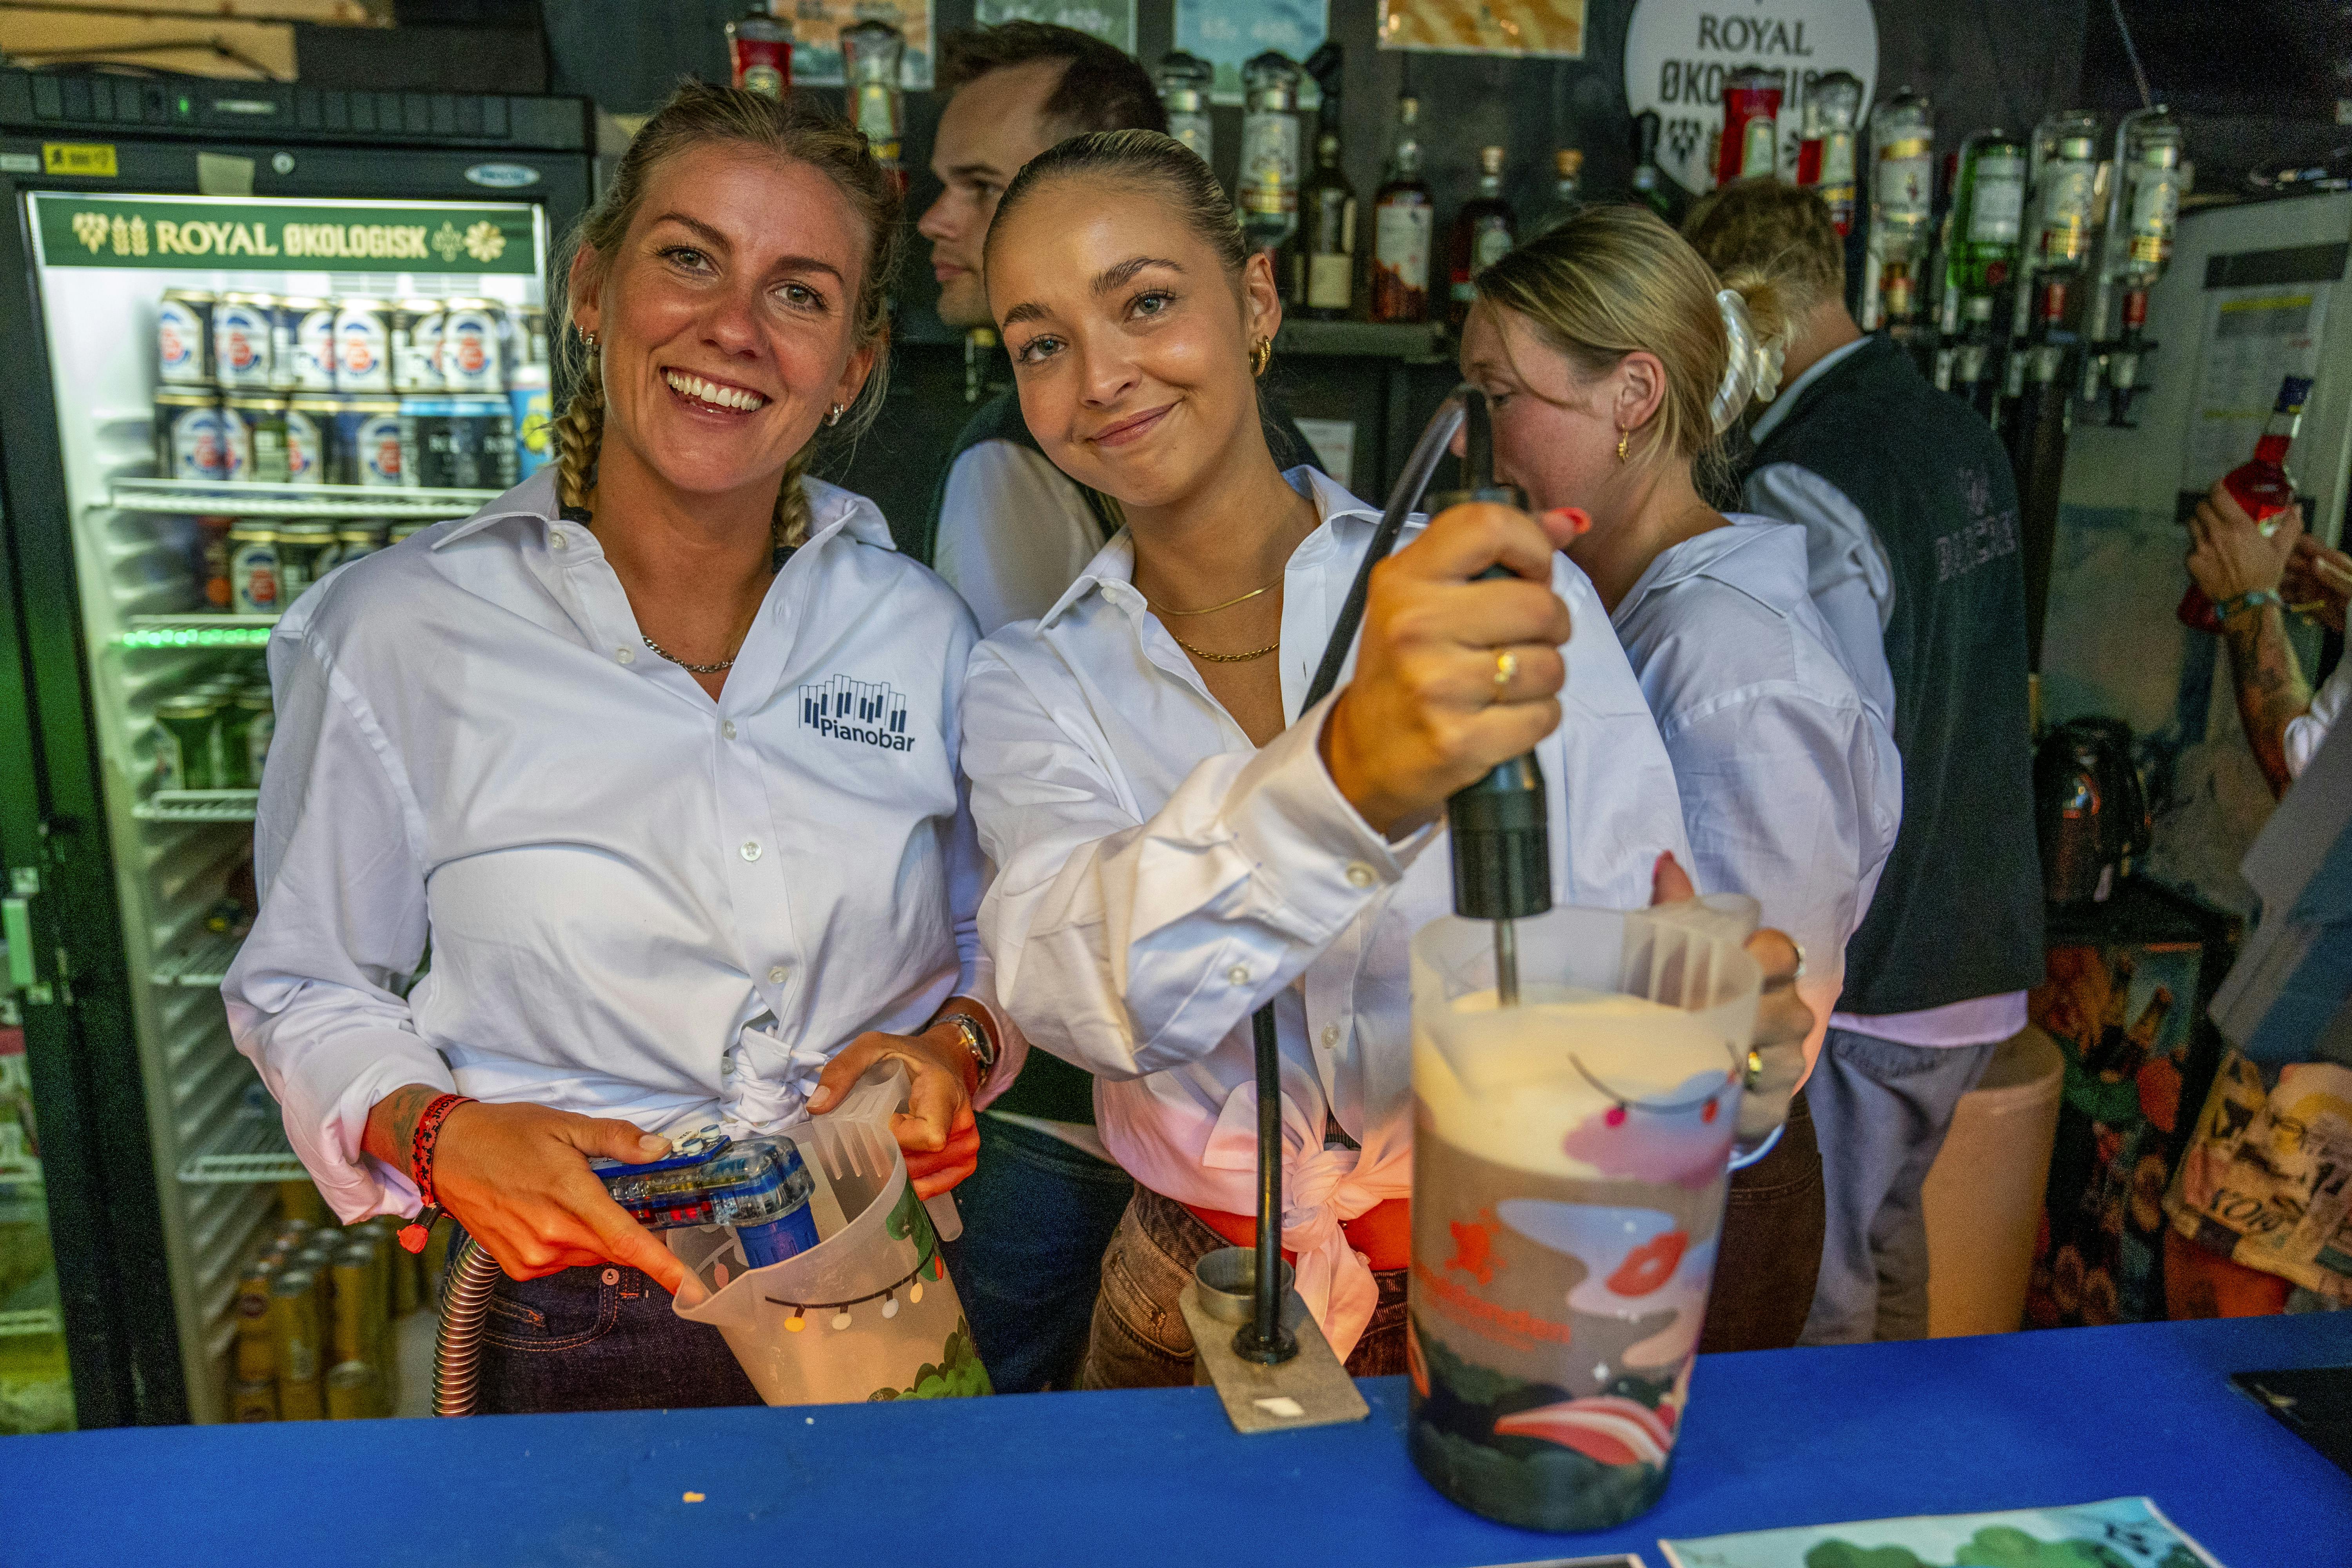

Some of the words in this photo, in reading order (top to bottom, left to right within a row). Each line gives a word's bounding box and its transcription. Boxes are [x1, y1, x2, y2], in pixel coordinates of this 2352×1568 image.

[1698, 13, 1813, 56] ROYAL
[156, 220, 278, 256] ROYAL
[283, 223, 429, 258] ØKOLOGISK
[820, 718, 915, 751] Pianobar
